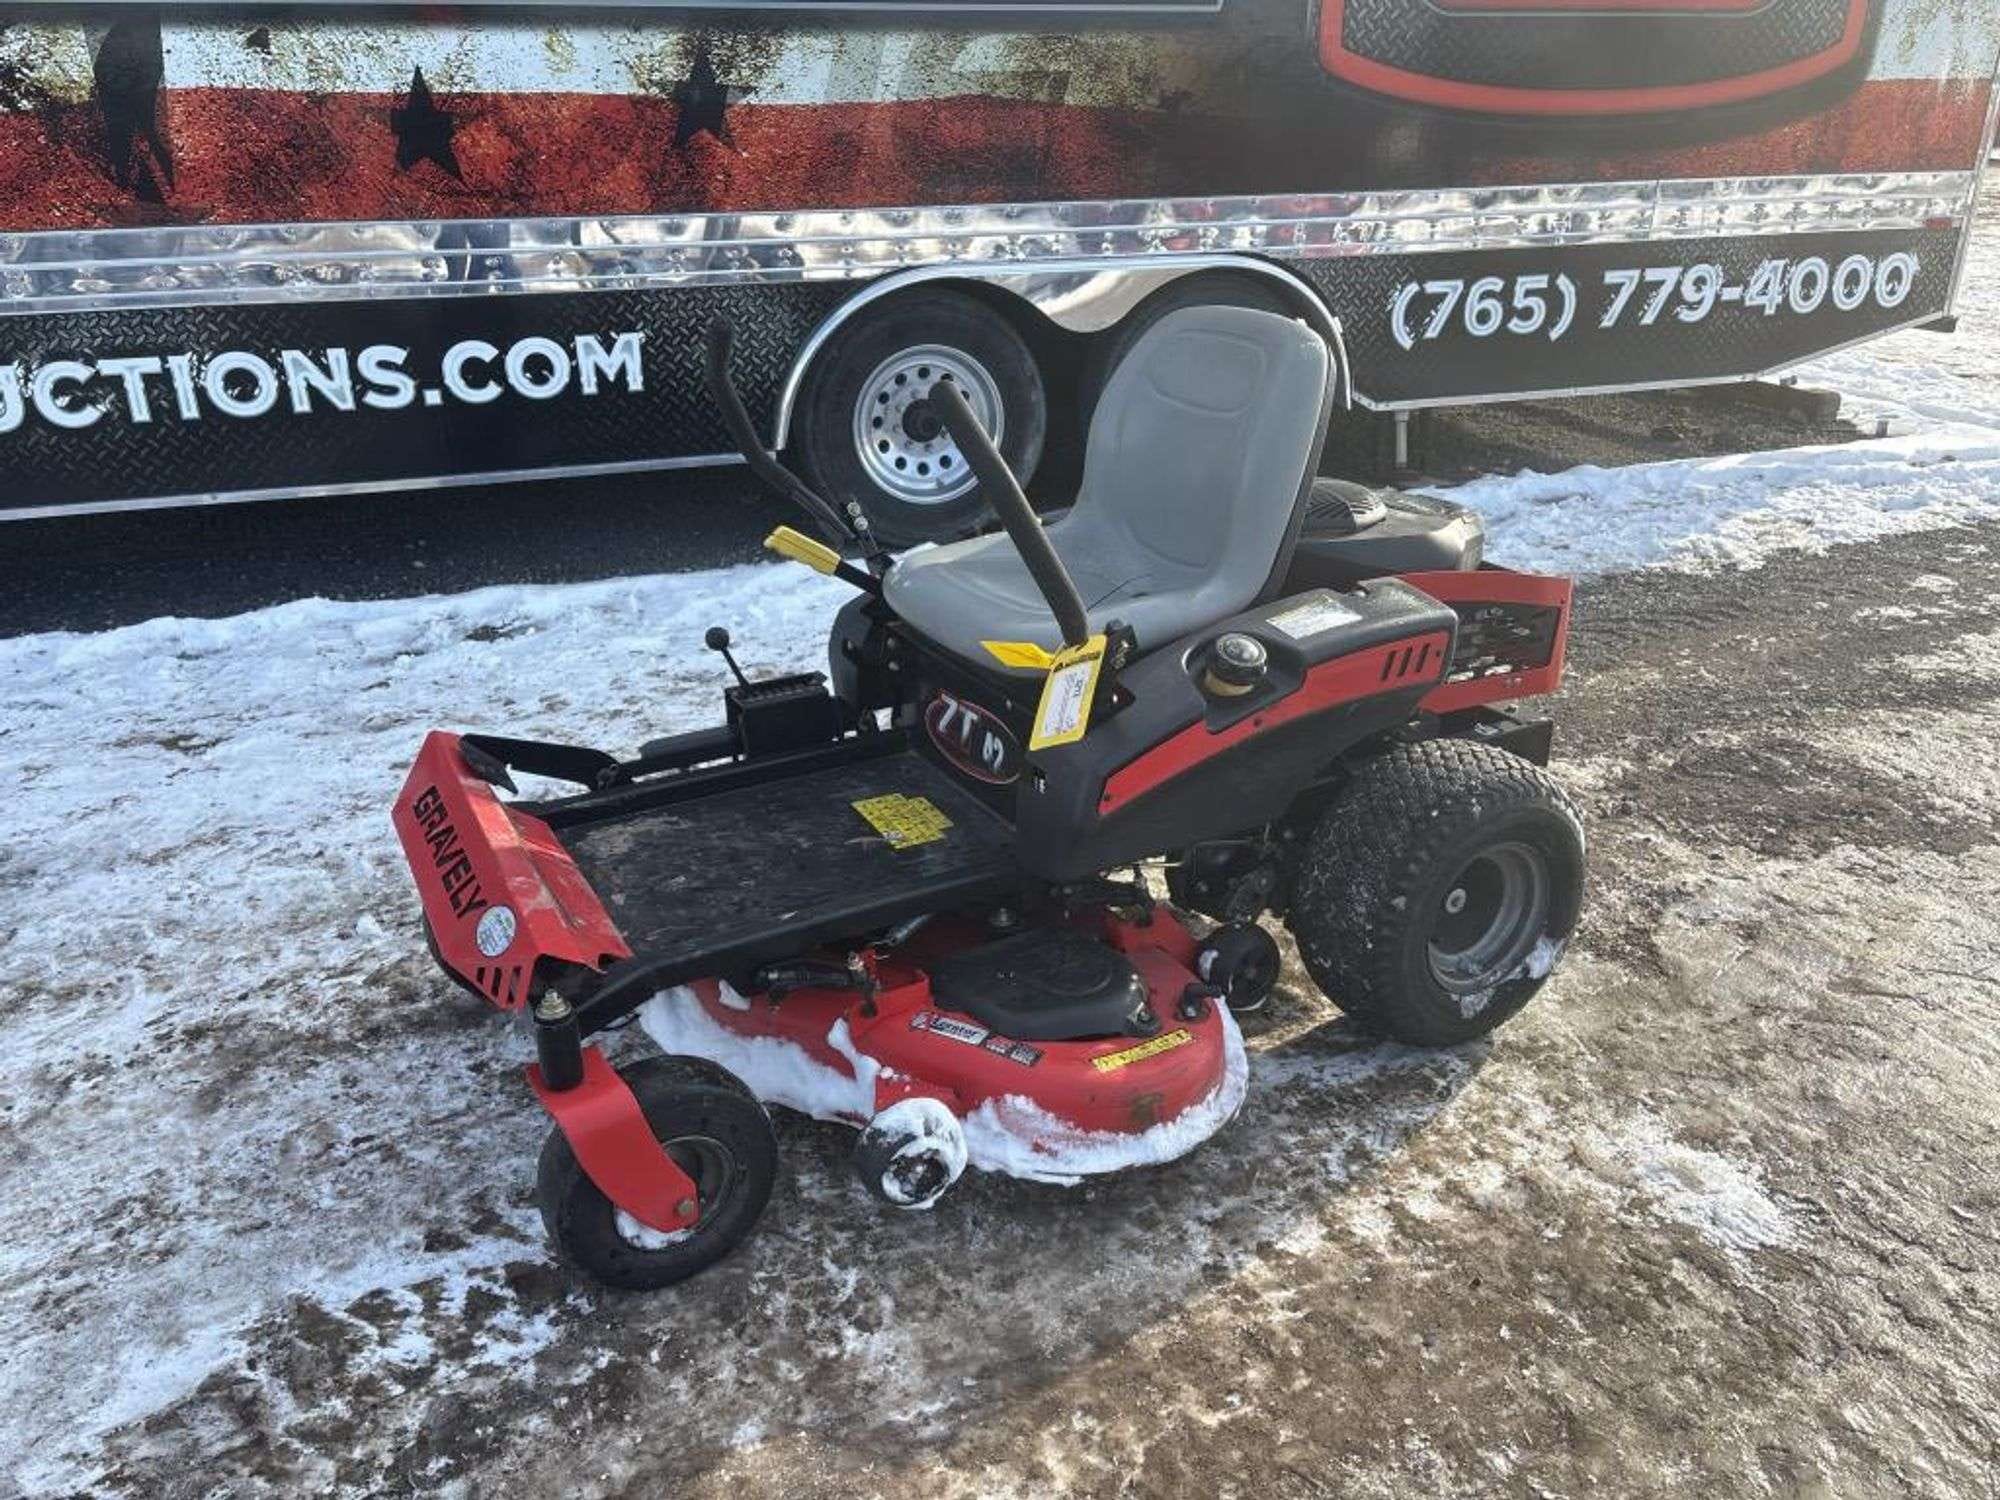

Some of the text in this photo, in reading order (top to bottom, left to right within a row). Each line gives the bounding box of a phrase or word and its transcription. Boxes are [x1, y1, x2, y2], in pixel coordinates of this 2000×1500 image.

[1390, 251, 1919, 350] (765) 779-4000
[412, 785, 488, 920] GRAVELY
